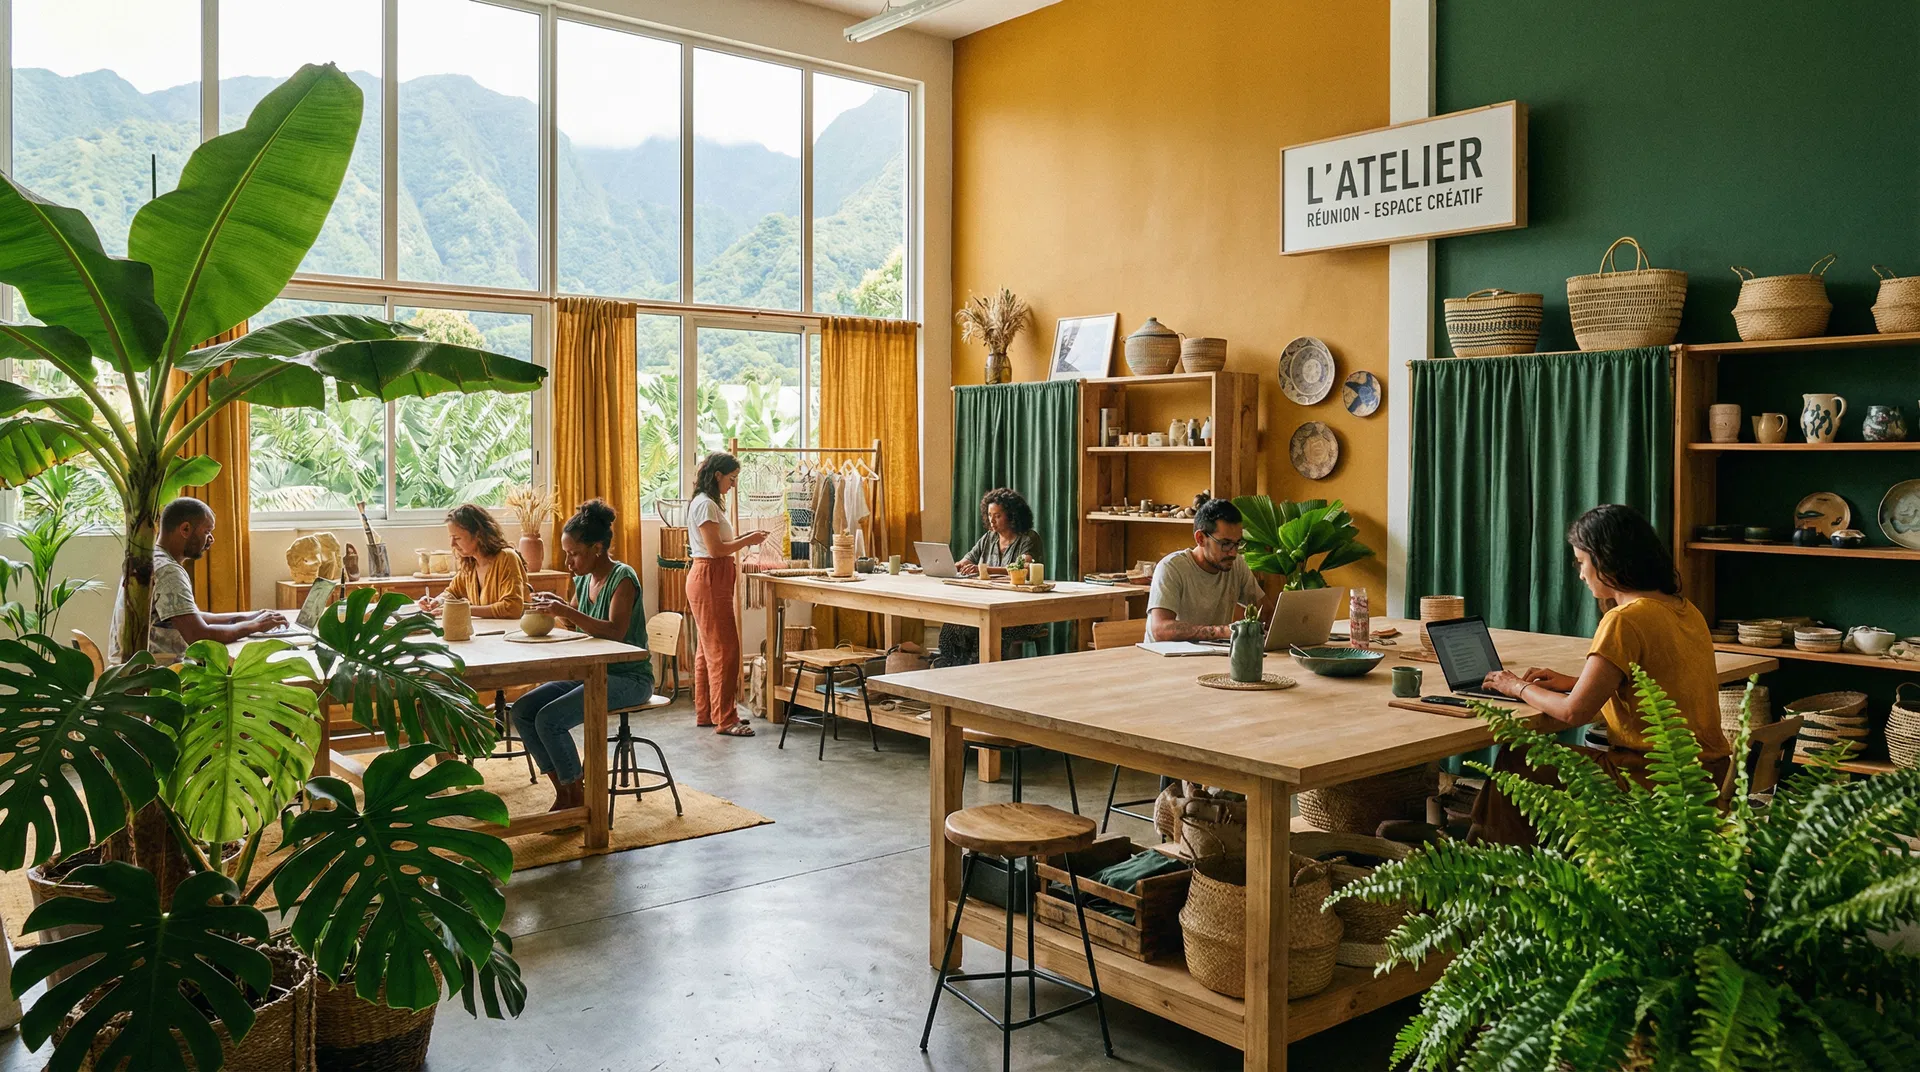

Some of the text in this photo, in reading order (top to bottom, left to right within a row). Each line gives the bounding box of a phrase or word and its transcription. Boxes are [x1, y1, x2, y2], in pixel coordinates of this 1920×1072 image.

[1307, 136, 1484, 205] L'ATELIER
[1307, 205, 1360, 228] RÉUNION
[1374, 196, 1422, 218] ESPACE
[1427, 186, 1484, 210] CRÉATIF
